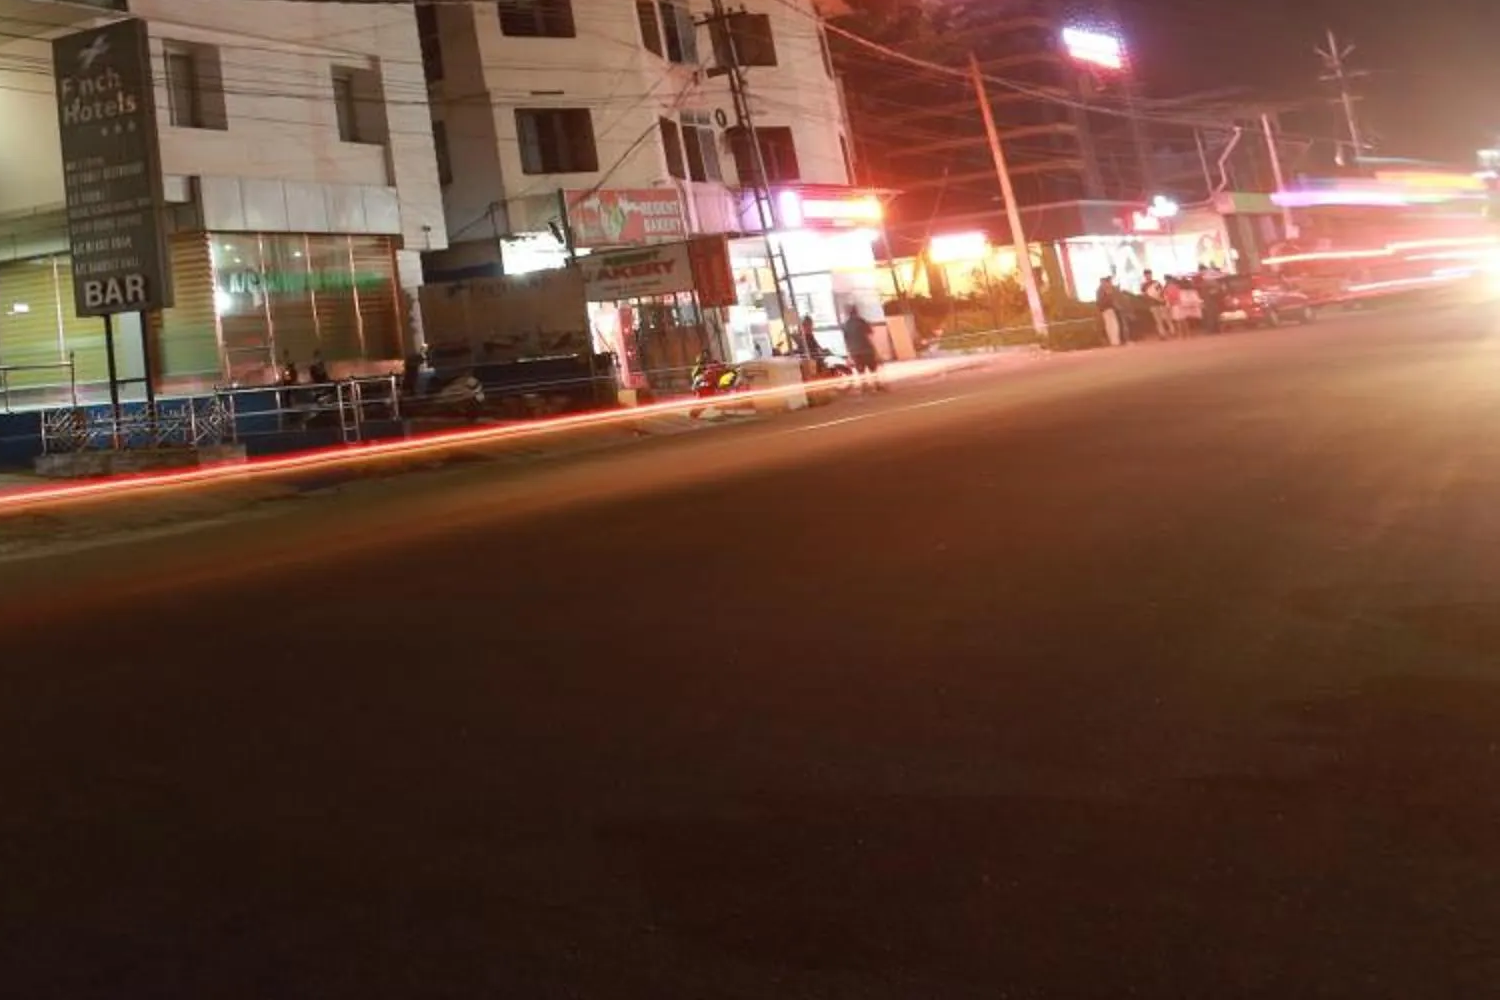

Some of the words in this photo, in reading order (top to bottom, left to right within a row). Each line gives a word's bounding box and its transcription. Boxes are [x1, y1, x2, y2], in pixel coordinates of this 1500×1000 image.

[61, 66, 122, 99] Fnch
[63, 90, 137, 127] Hotels
[583, 258, 676, 283] AKERY
[84, 272, 145, 308] BAR
